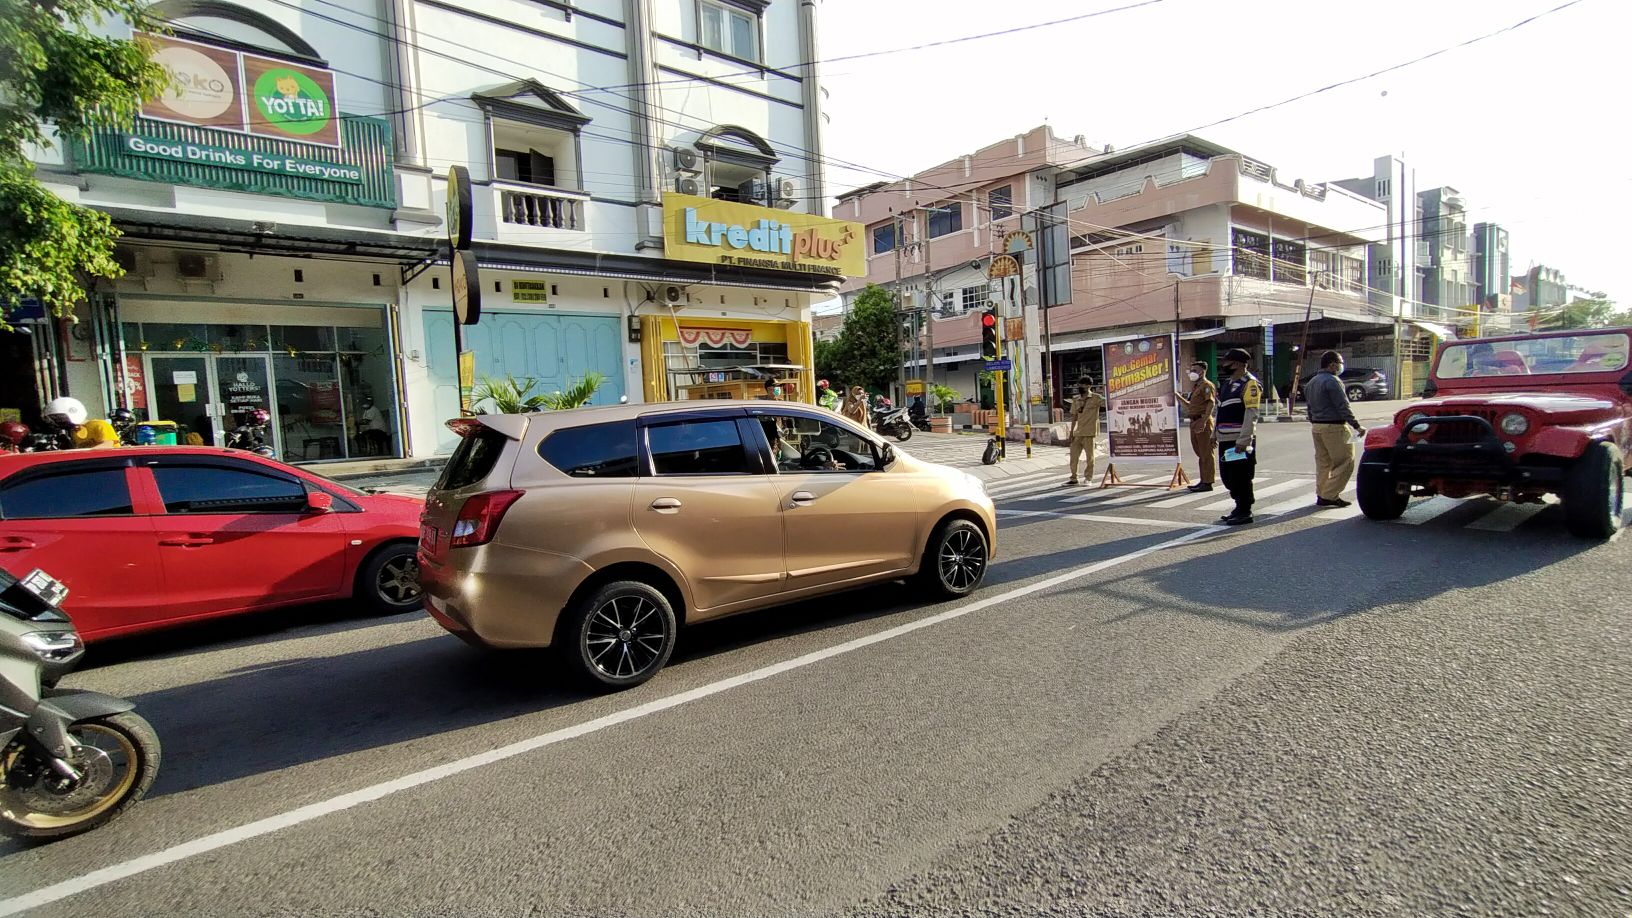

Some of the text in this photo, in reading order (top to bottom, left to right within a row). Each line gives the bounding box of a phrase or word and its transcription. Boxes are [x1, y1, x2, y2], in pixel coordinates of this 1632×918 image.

[261, 95, 325, 117] YOTTA!
[129, 137, 359, 180] Good Drinks For Everyone
[721, 254, 842, 276] PT. FINANSIA MULTI FINANCE
[1108, 362, 1162, 392] Bermasker
